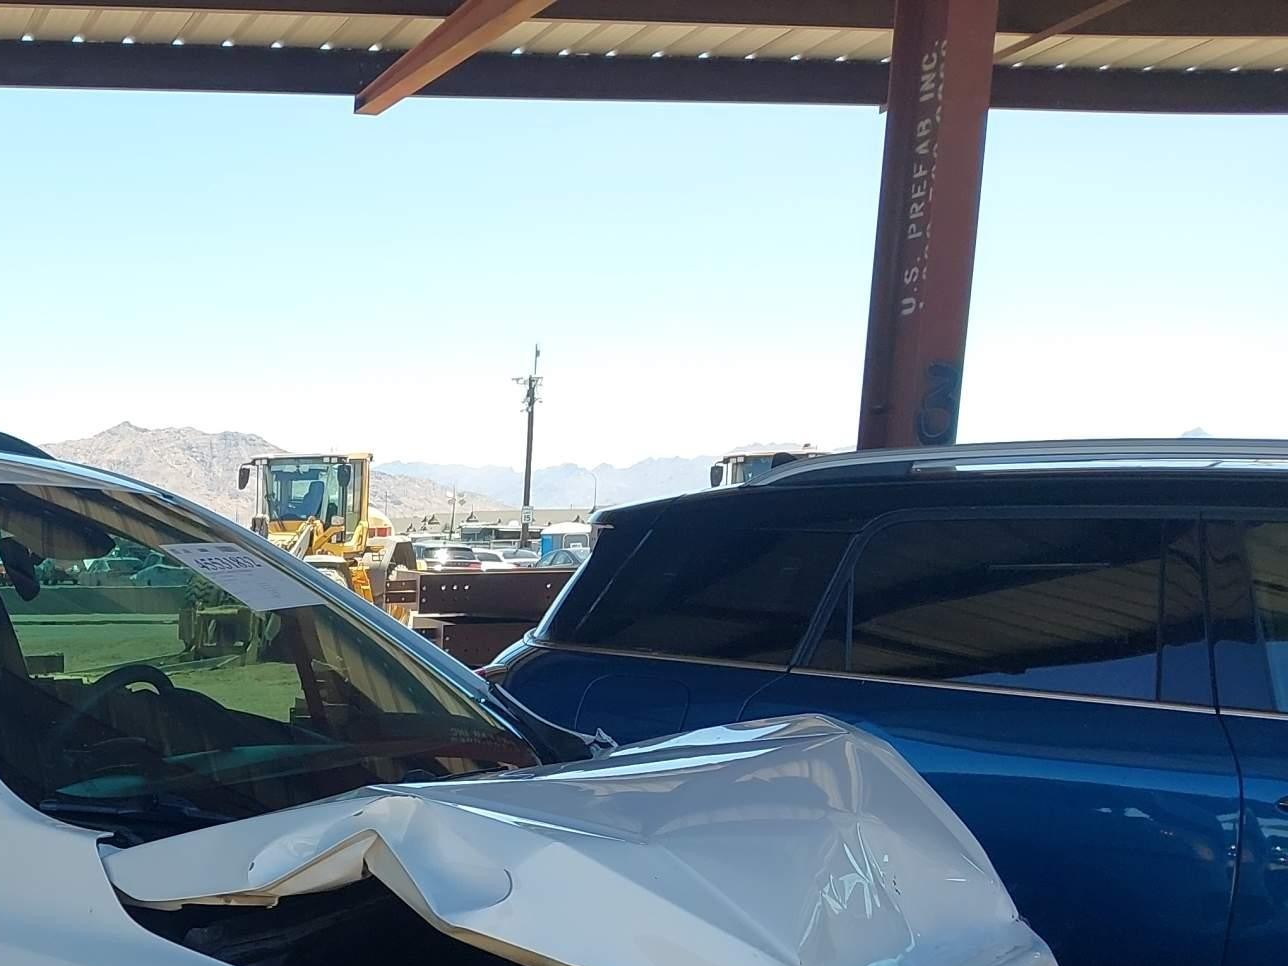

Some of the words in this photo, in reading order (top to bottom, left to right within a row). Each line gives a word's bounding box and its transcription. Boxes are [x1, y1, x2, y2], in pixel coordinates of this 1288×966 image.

[919, 40, 939, 101] INC.
[907, 119, 932, 241] PREFAB
[900, 256, 921, 316] U.S.
[194, 555, 263, 572] 45531832
